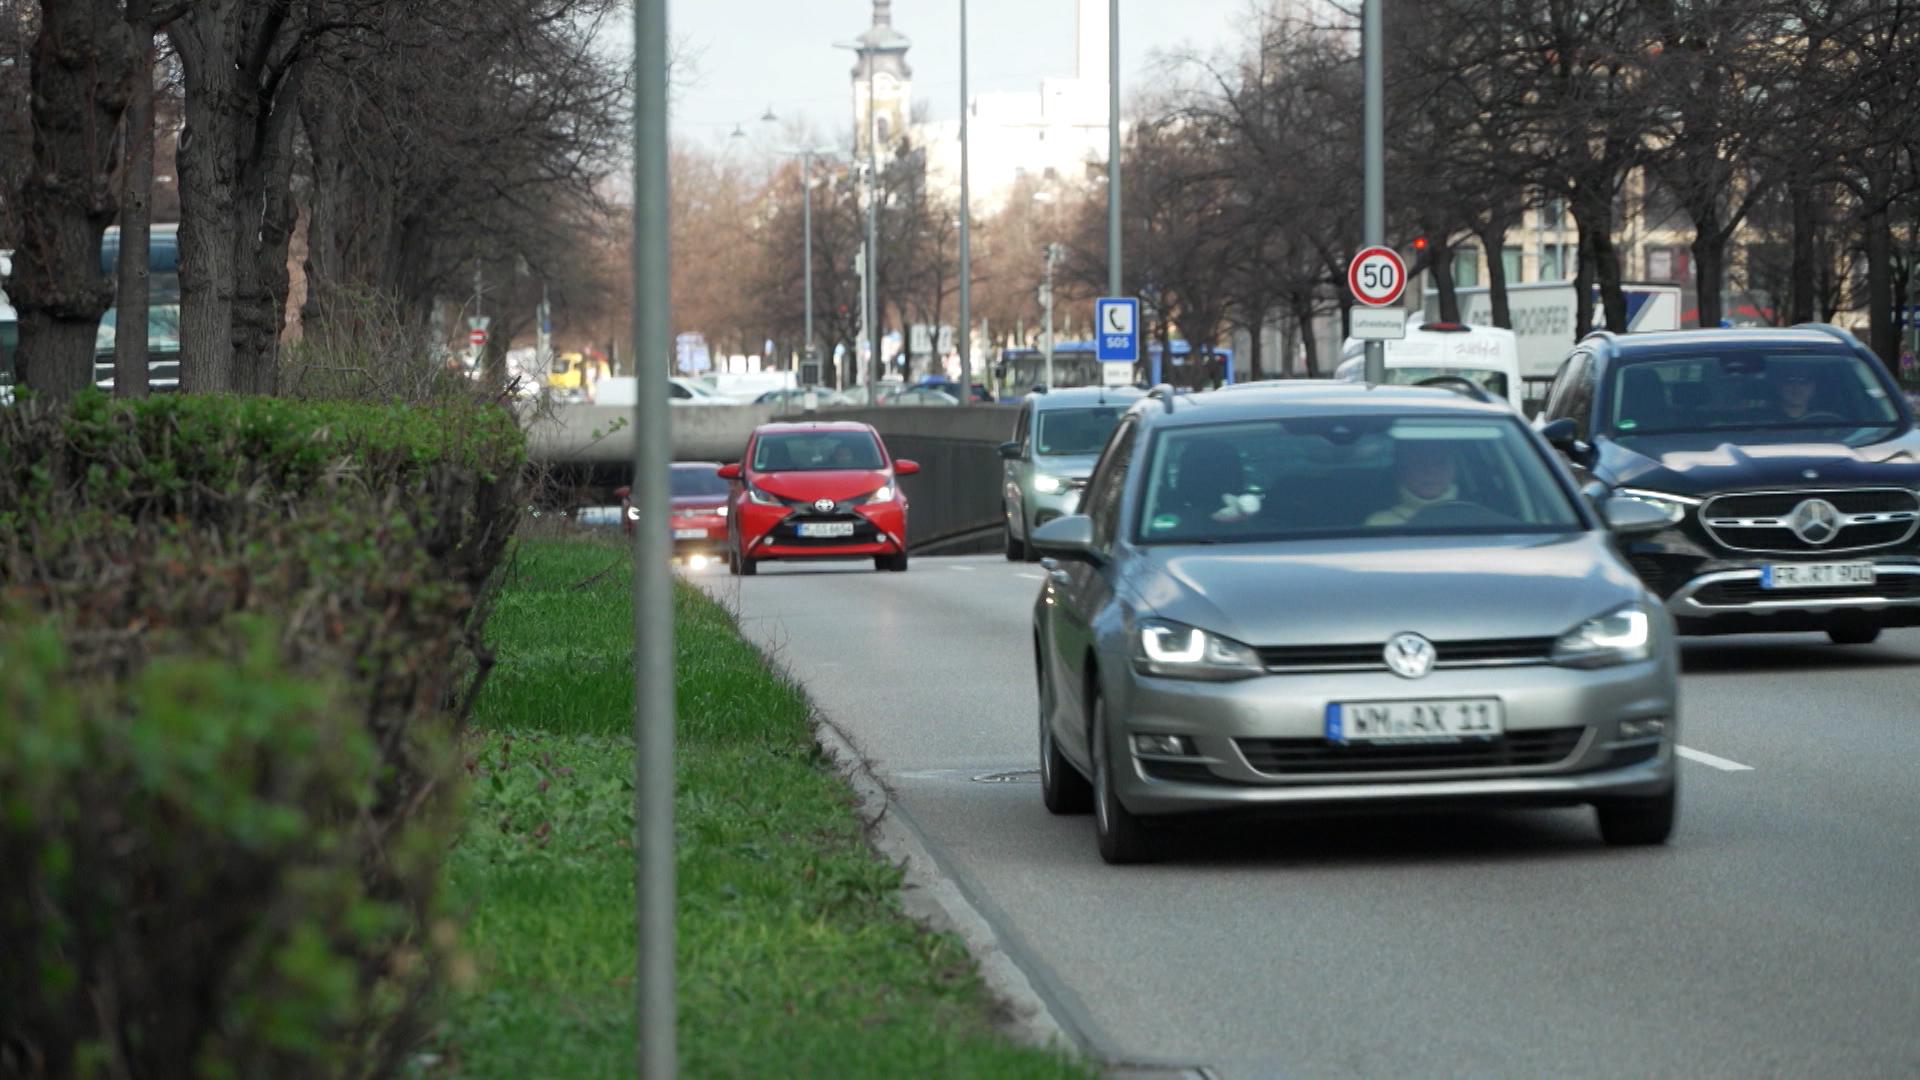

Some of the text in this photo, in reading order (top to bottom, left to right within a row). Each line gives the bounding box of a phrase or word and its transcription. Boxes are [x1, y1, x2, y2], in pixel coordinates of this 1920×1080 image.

[1362, 263, 1394, 289] 50
[1106, 336, 1130, 348] SOS
[1352, 703, 1492, 734] WM AX 11
